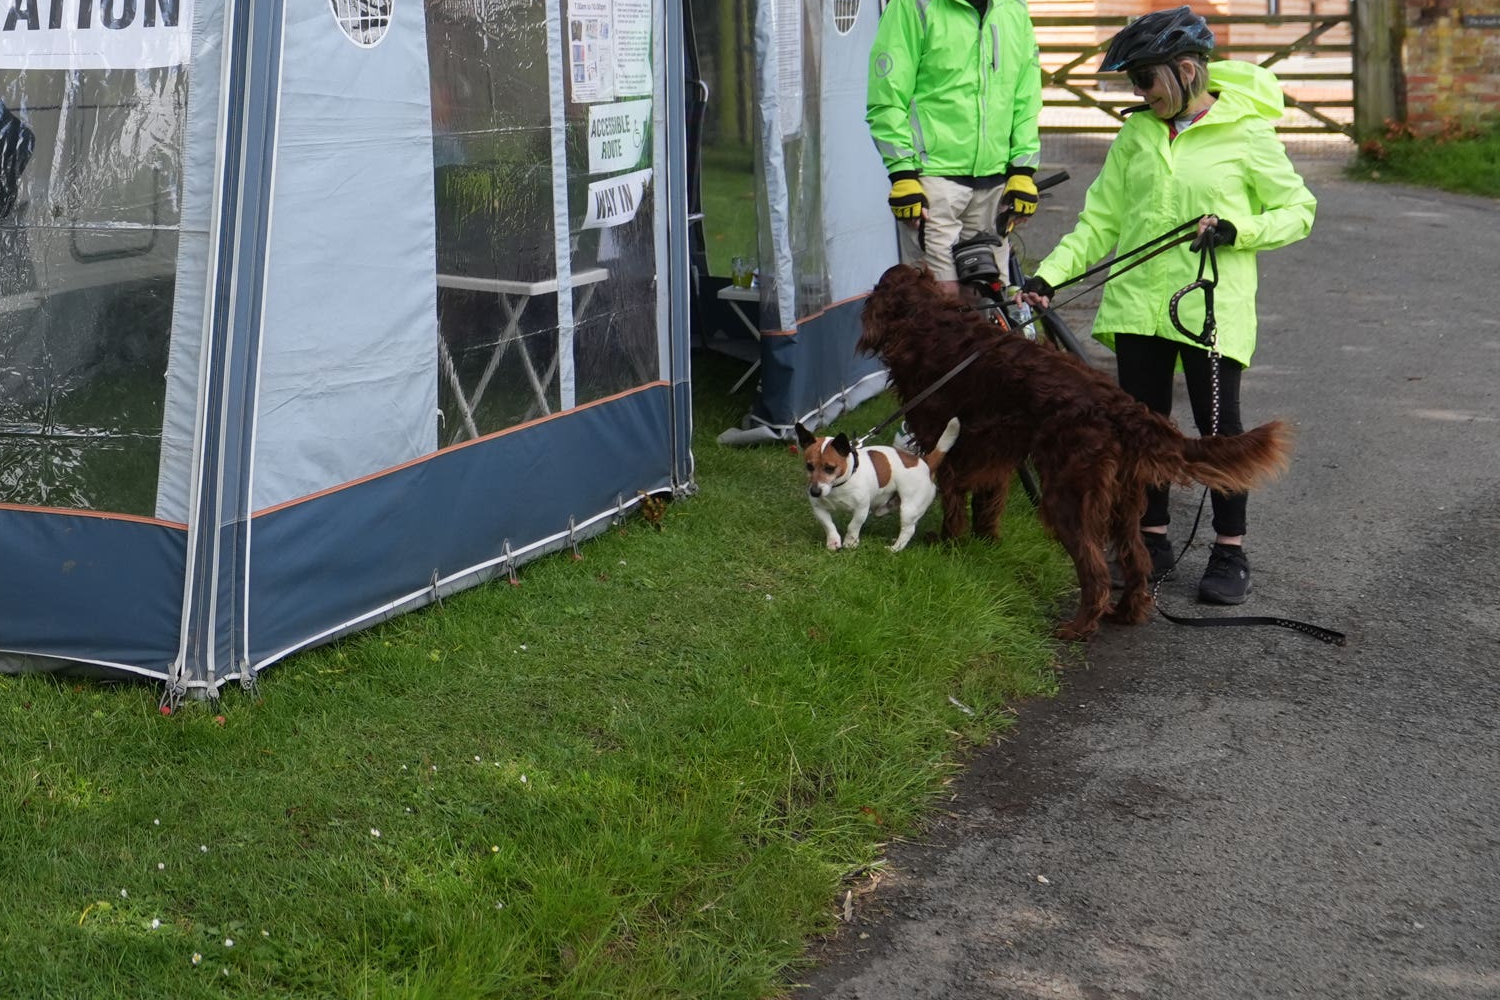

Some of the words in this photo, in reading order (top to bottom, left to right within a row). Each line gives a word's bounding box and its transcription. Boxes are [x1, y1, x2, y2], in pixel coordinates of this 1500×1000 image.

[590, 114, 631, 138] ACCESSIBLE
[601, 139, 623, 160] ROUTE
[595, 187, 618, 220] WAY
[618, 183, 634, 212] IN
